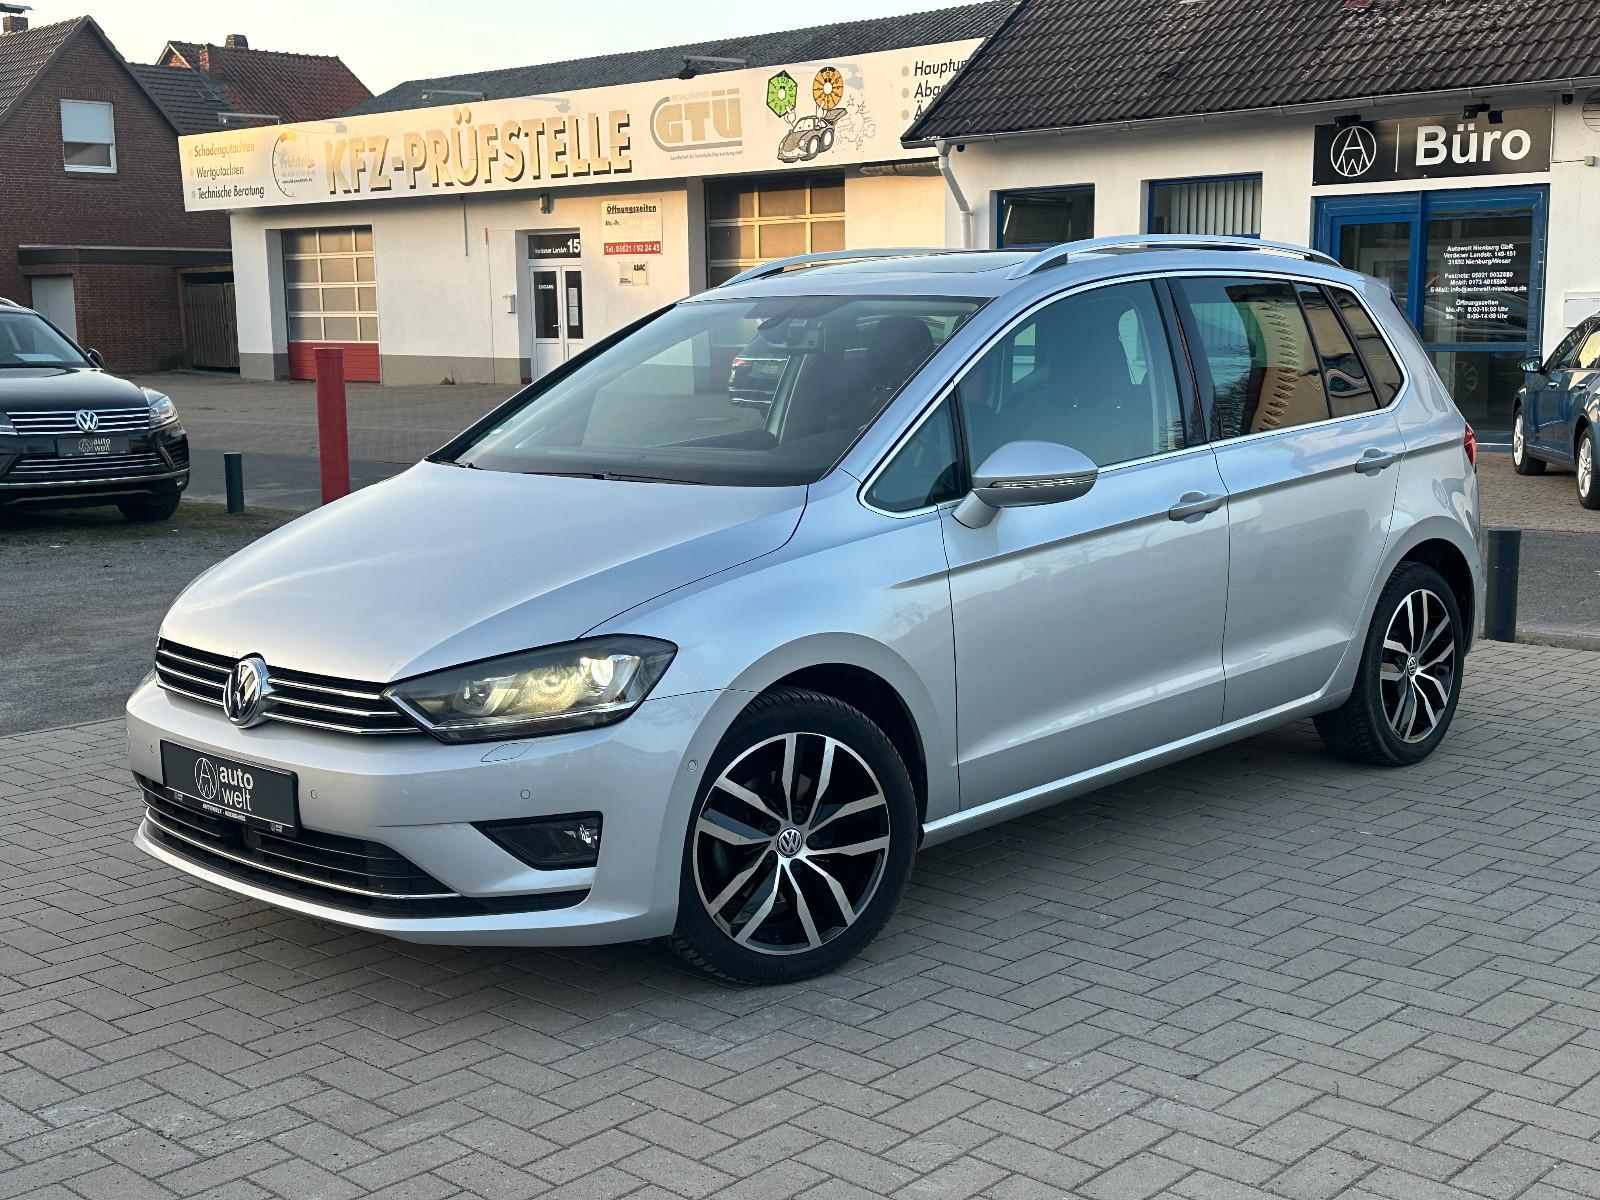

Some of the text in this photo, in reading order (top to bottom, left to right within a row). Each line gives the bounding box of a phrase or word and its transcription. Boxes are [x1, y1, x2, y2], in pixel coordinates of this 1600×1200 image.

[194, 142, 255, 158] Schadengutachten
[324, 107, 632, 194] KFZ-PRÜFSTELLE
[1416, 123, 1531, 166] Büro
[196, 163, 244, 180] Wertgutachten
[198, 184, 265, 199] Technische Beratung
[606, 204, 657, 213] Öffnungszeiten
[219, 766, 254, 790] auto
[221, 787, 252, 811] welt
